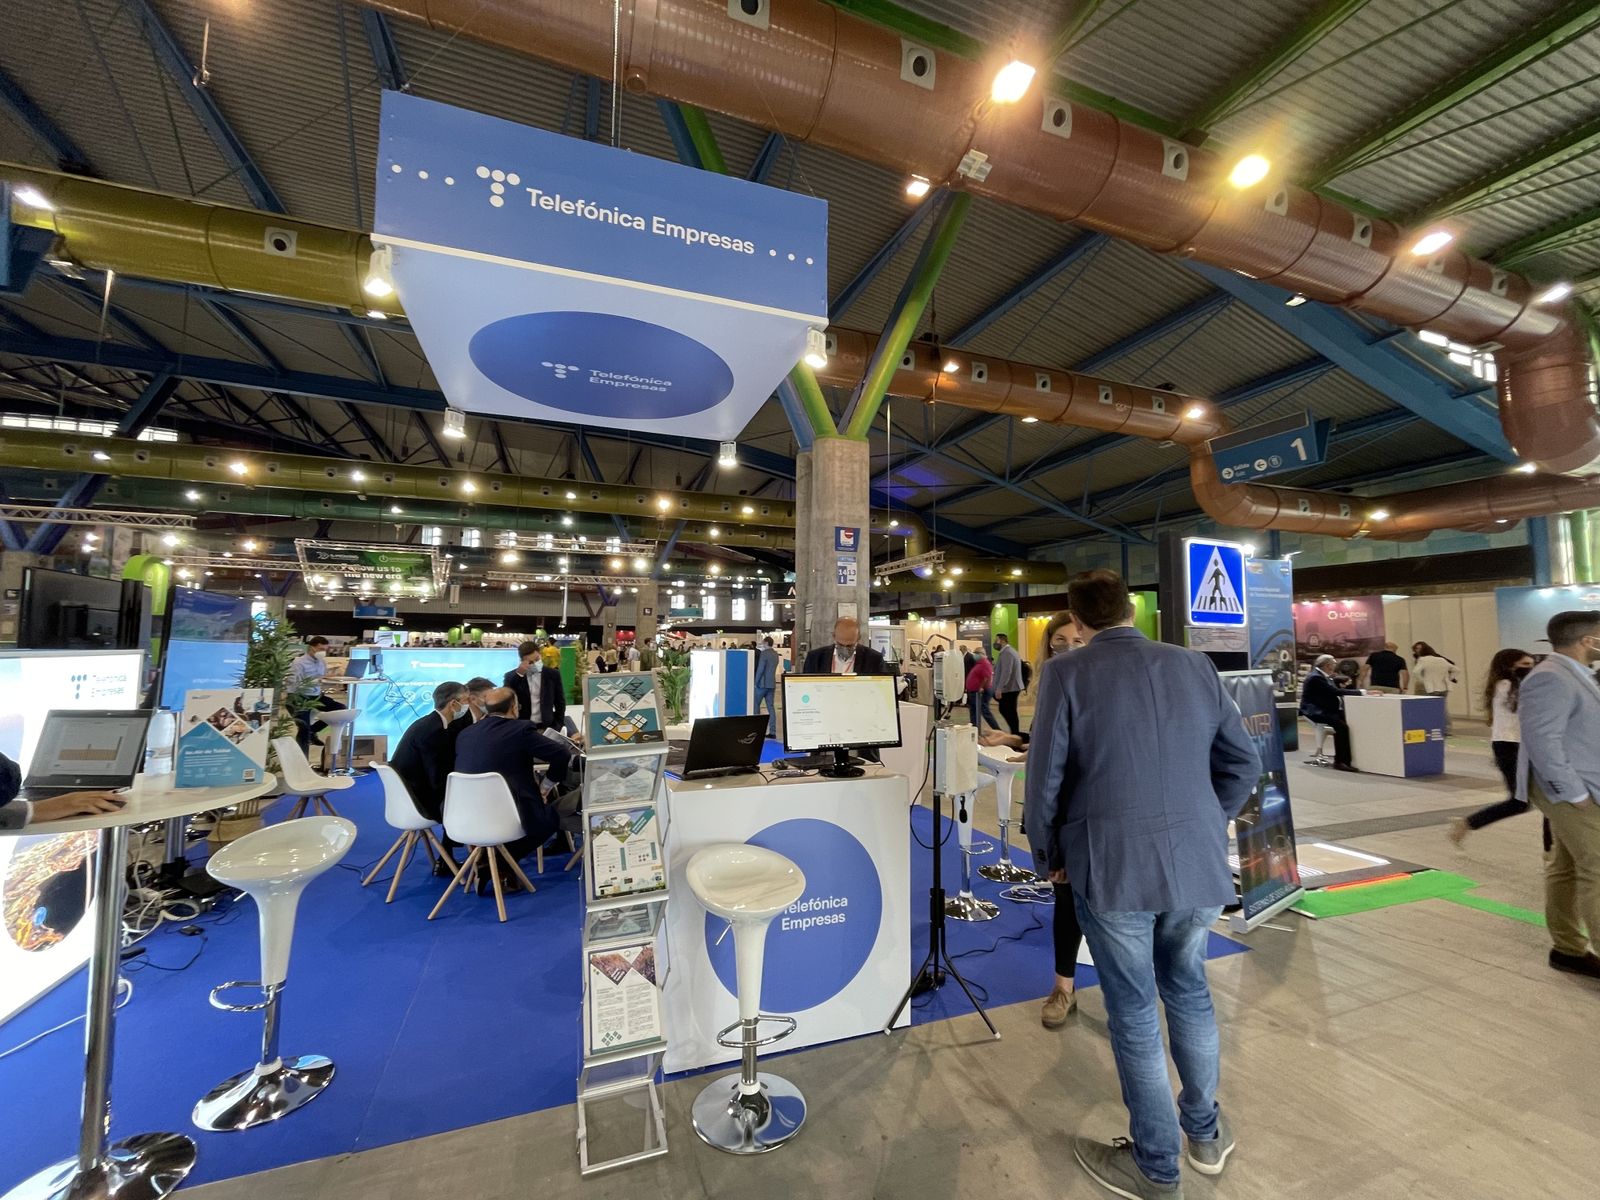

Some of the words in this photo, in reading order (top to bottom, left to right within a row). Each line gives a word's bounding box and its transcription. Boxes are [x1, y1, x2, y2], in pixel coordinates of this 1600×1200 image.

[526, 188, 646, 231] Telefónica
[652, 216, 755, 254] Empresas
[589, 369, 673, 387] Telefónica
[589, 376, 667, 392] Empresas
[1290, 437, 1308, 461] 1
[781, 913, 846, 931] Empresas
